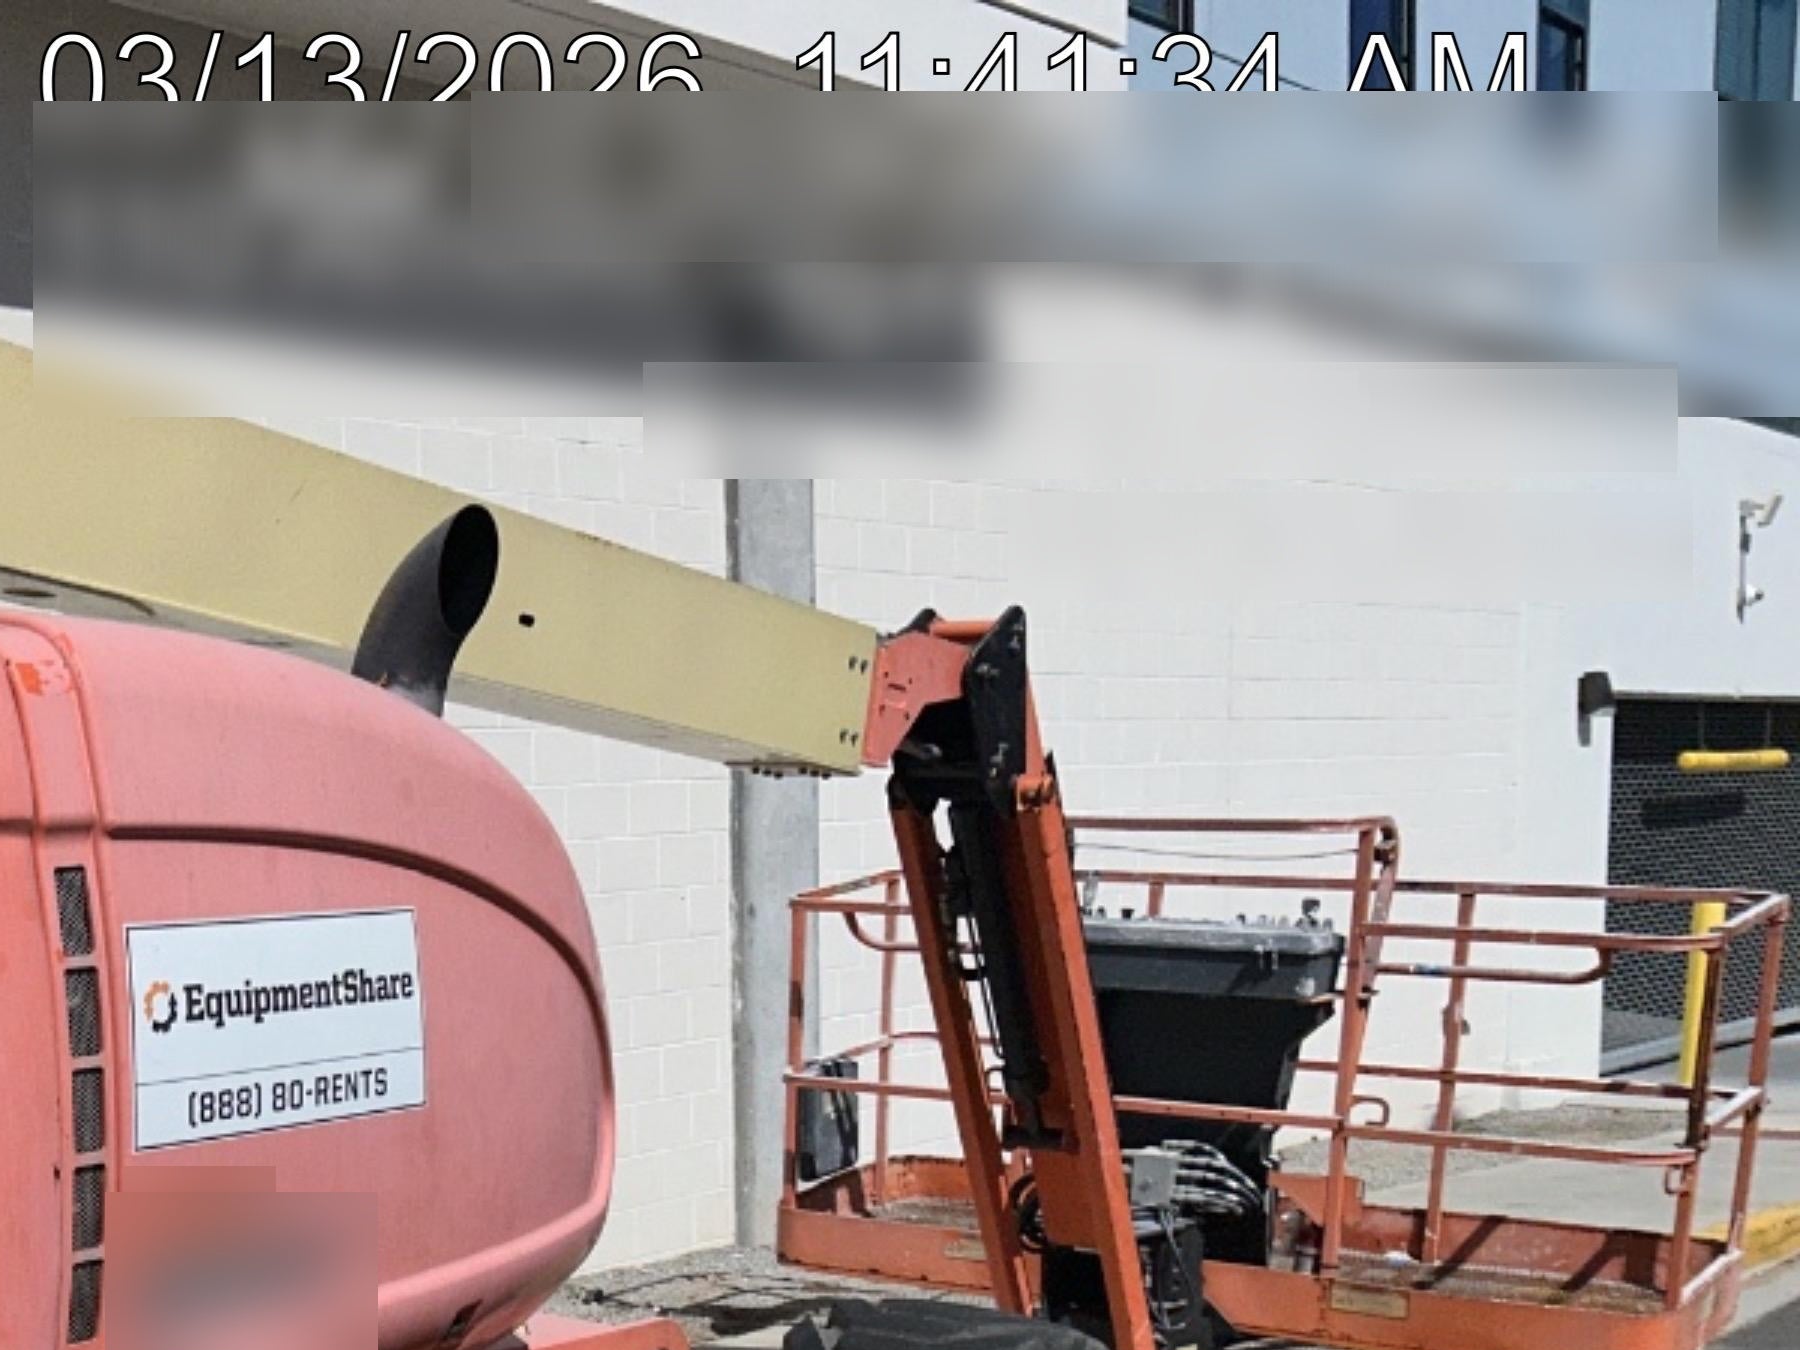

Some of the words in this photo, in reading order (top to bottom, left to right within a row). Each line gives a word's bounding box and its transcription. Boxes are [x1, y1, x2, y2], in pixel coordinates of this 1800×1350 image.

[183, 968, 413, 1028] EquipmentShare
[188, 1082, 262, 1128] (888)
[272, 1067, 388, 1112] 80-RENTS
